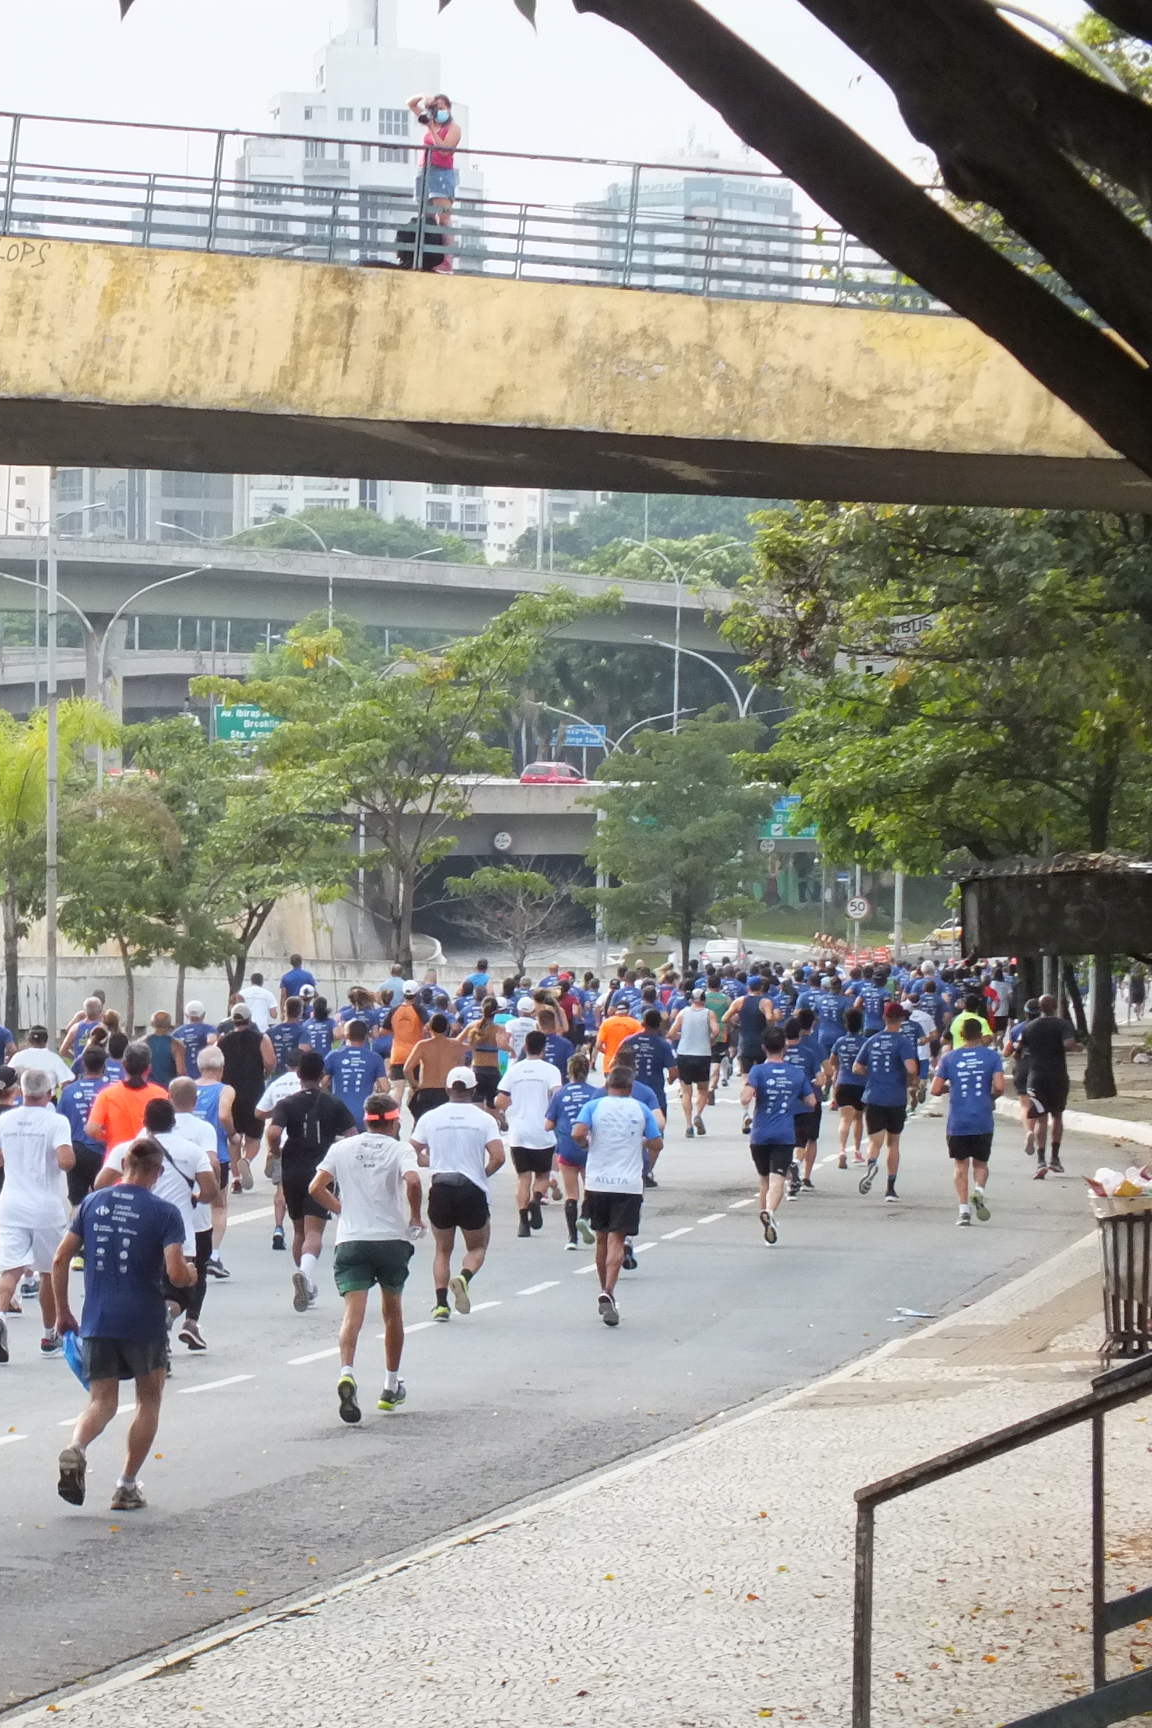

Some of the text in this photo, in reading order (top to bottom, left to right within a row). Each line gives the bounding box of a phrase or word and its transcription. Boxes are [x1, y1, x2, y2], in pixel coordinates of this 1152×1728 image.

[243, 719, 280, 728] Brooklin
[230, 730, 273, 738] Sto. Amar
[850, 901, 866, 912] 50
[594, 1176, 629, 1185] ATLETA
